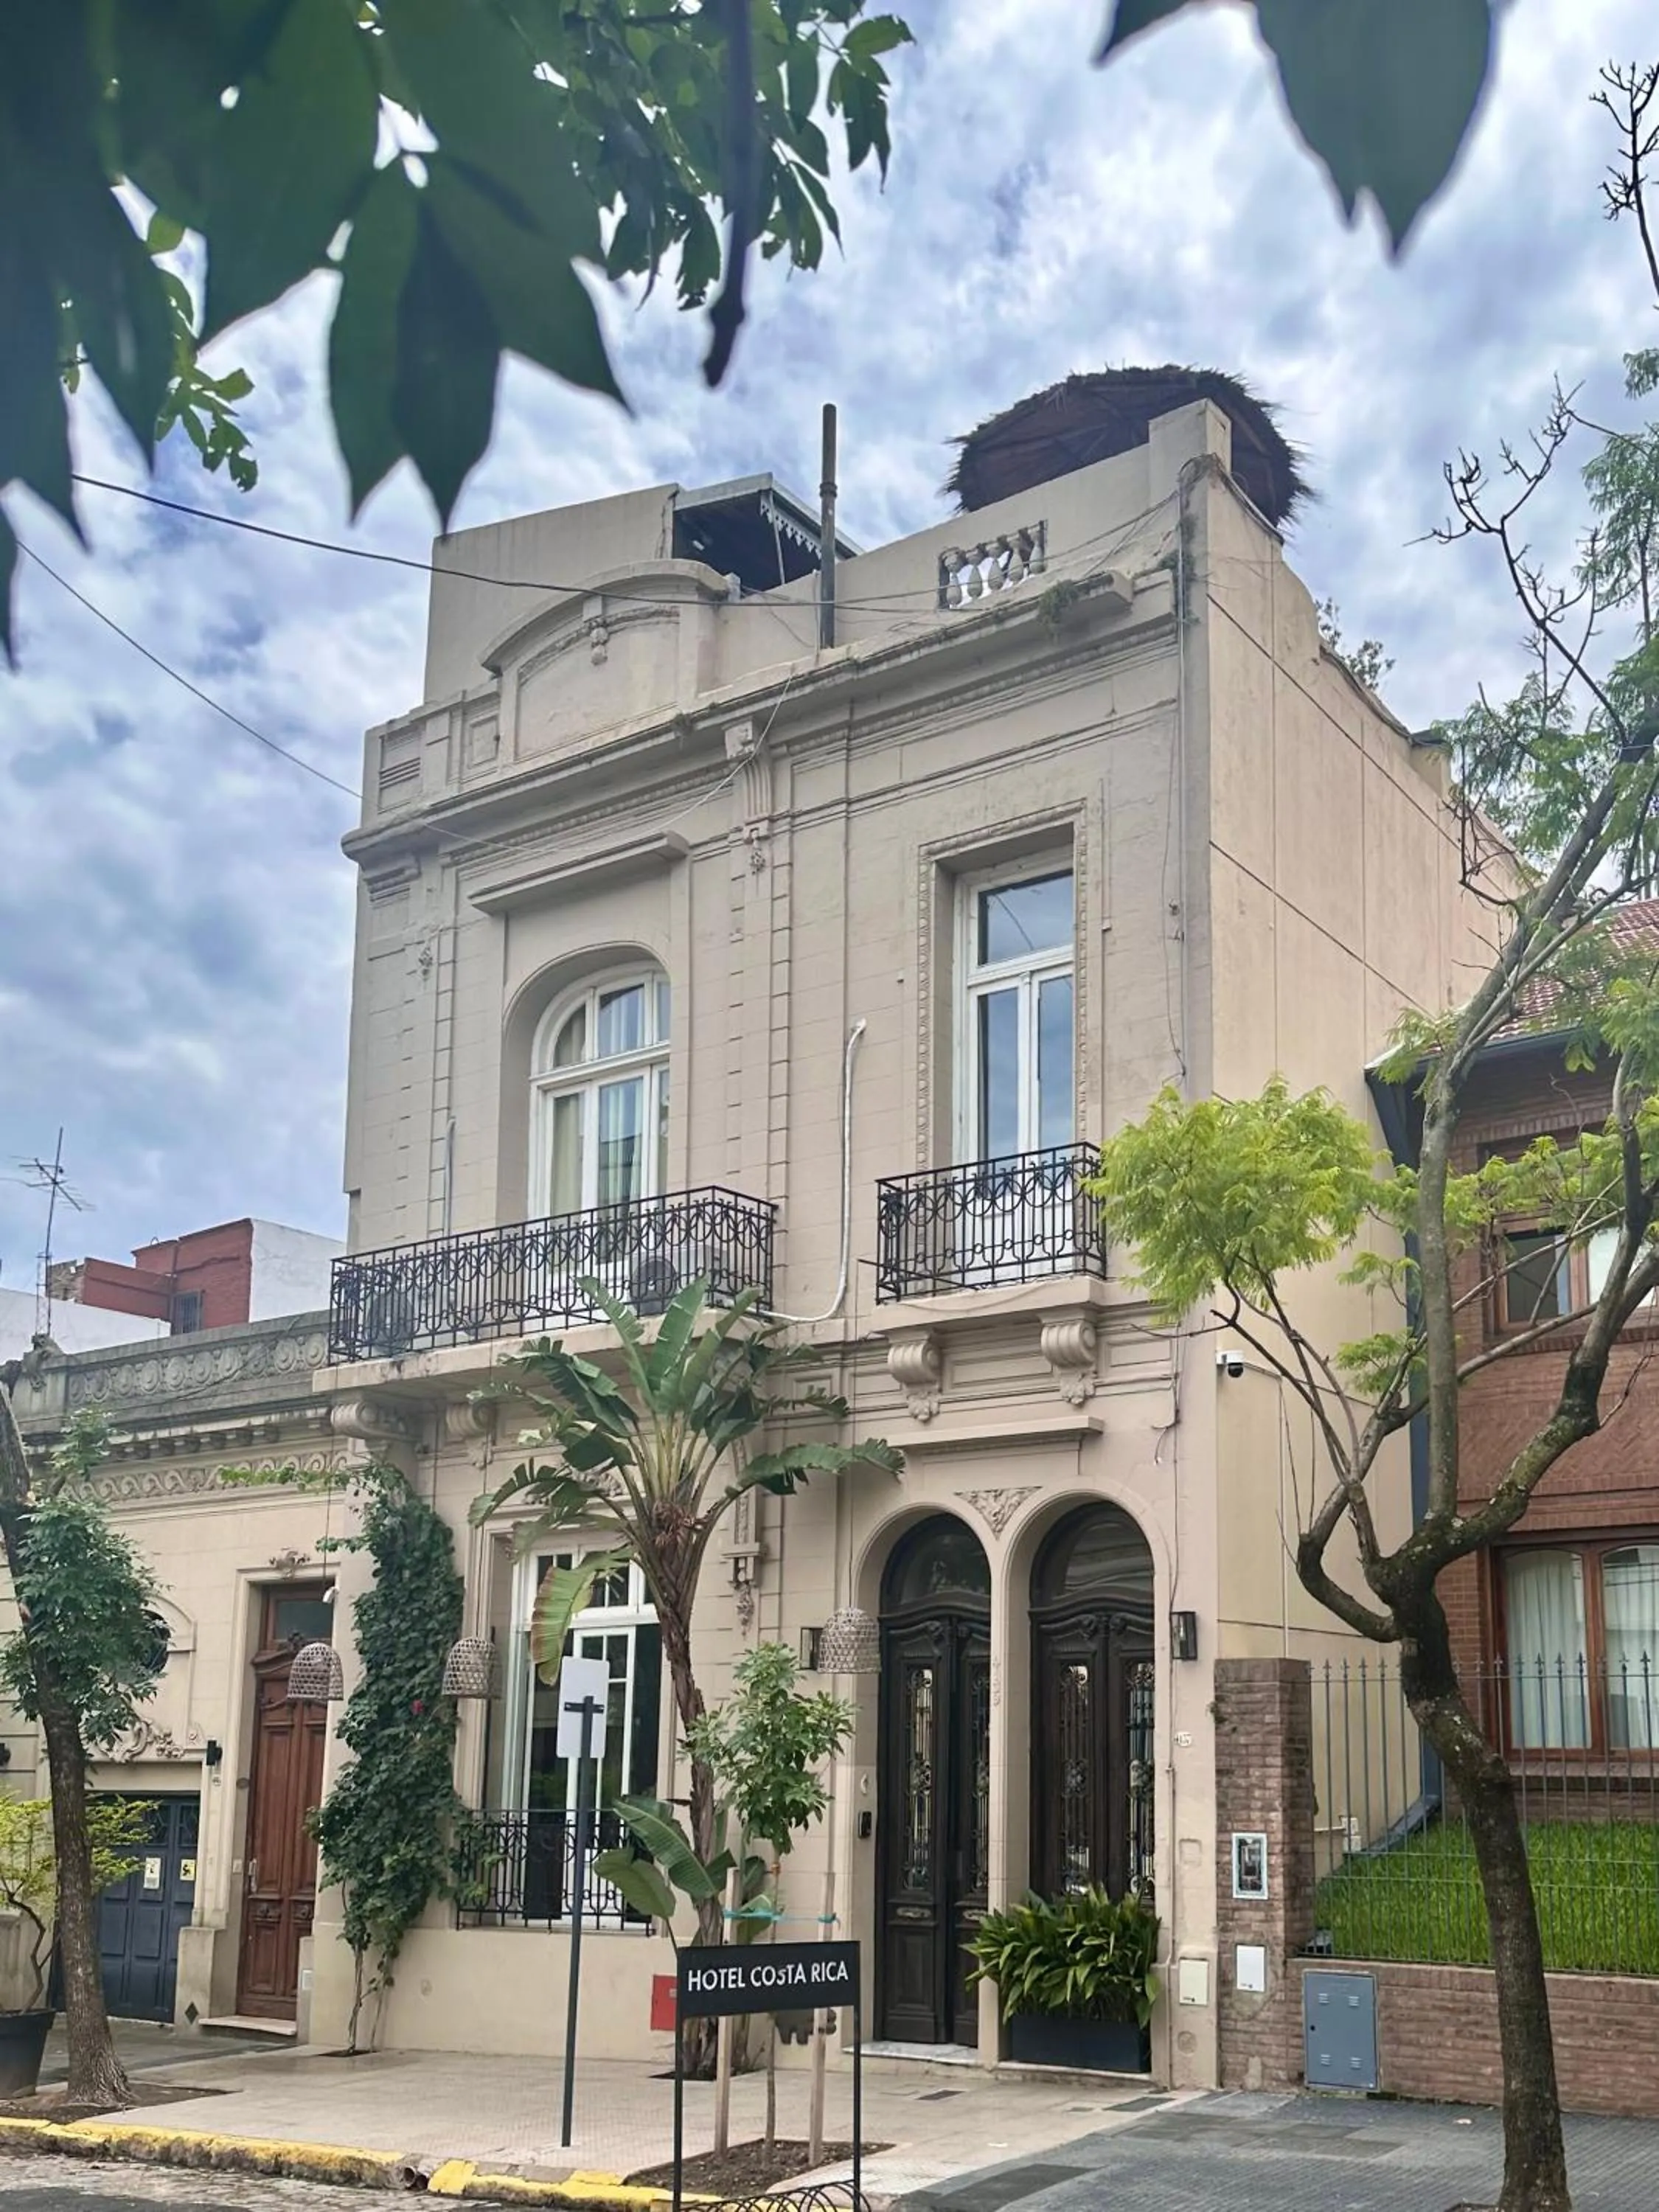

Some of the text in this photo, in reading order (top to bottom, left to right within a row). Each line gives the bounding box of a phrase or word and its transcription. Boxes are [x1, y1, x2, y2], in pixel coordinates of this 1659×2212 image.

[688, 1961, 849, 1991] HOTEL COSTA RICA
